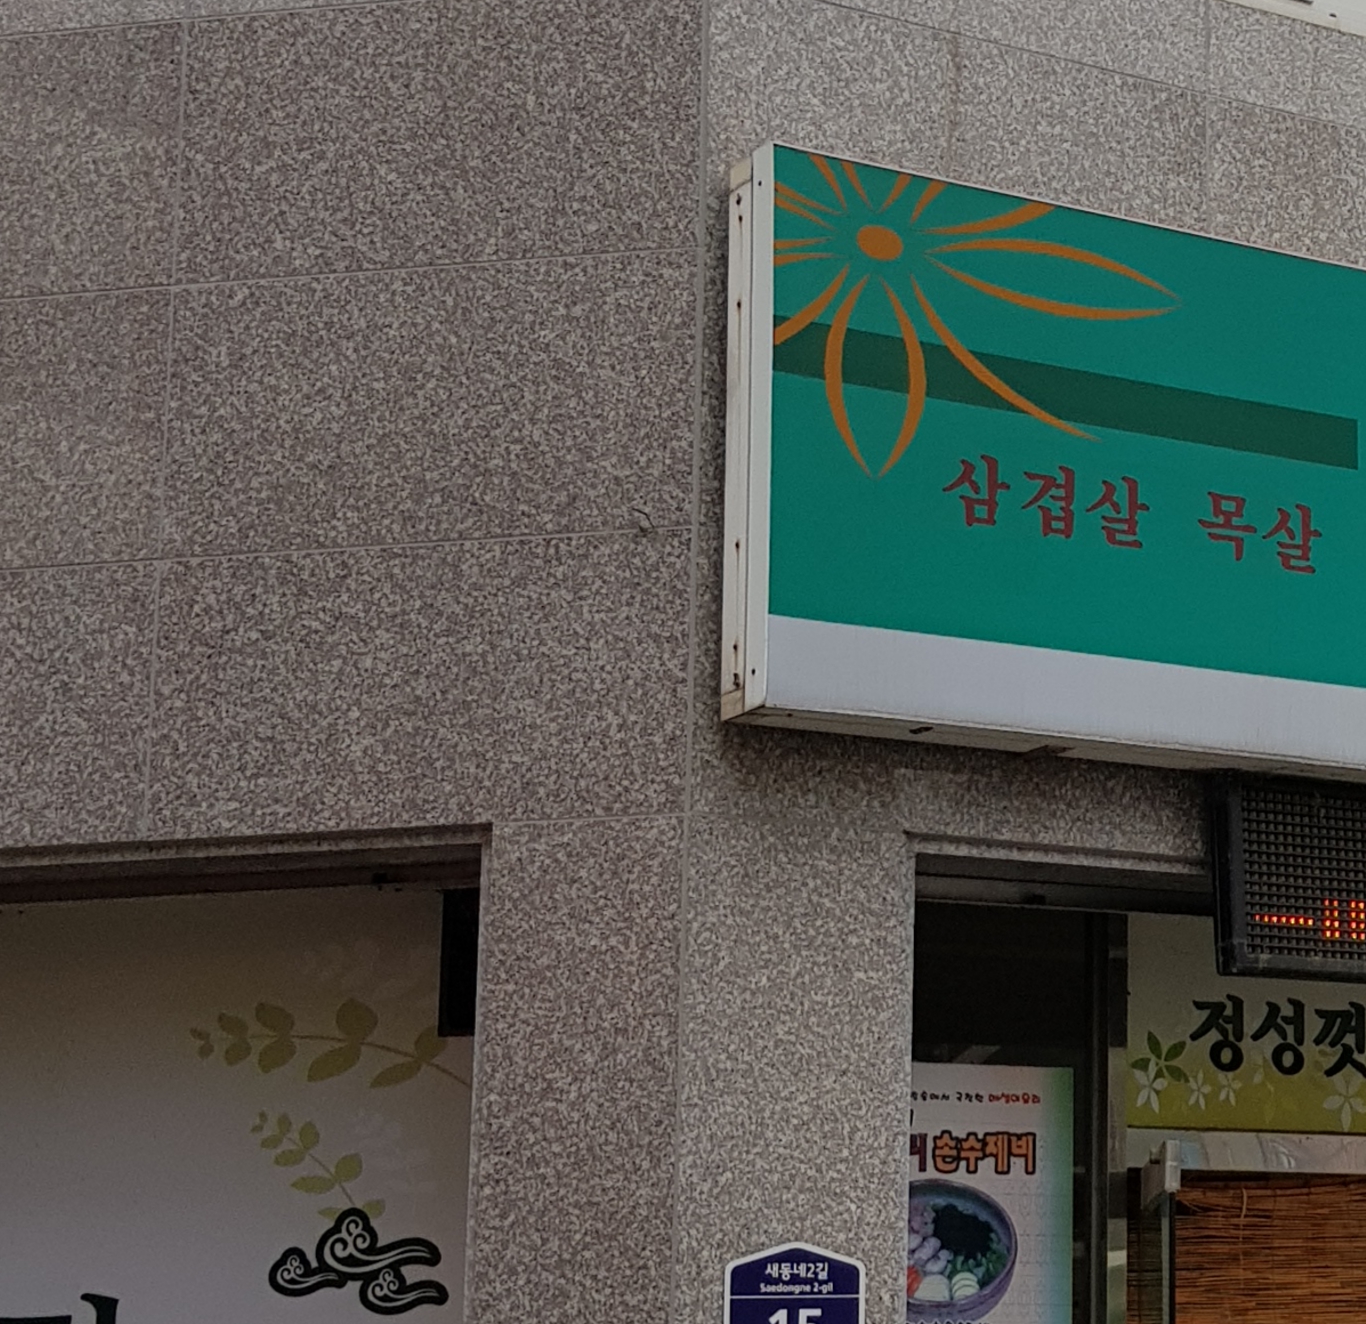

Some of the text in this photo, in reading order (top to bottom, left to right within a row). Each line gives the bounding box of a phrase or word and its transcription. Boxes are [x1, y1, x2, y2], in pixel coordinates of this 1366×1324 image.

[942, 454, 1151, 550] 삼겹살
[1197, 490, 1323, 575] 목살
[932, 1128, 1038, 1176] 손수제비
[764, 1261, 829, 1281] 새동네2길
[759, 1282, 834, 1295] Saedongne 2-gil
